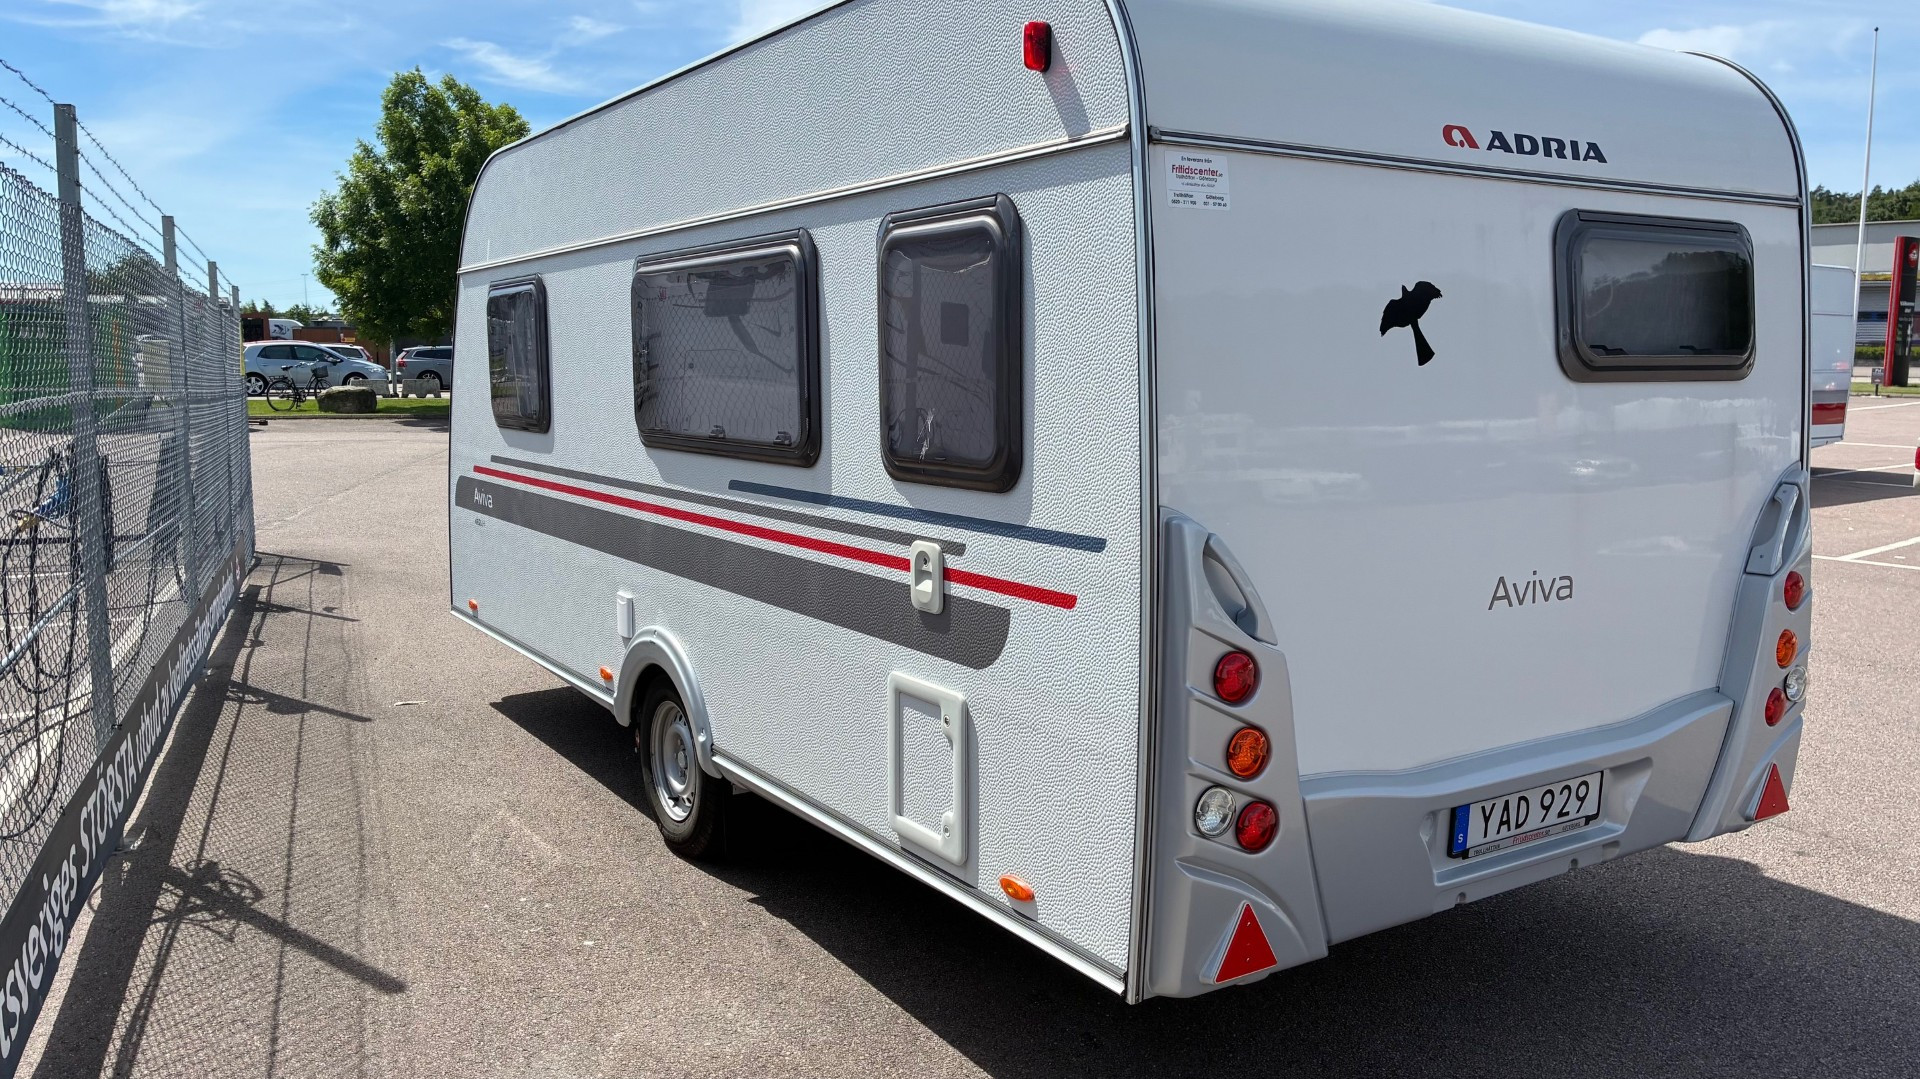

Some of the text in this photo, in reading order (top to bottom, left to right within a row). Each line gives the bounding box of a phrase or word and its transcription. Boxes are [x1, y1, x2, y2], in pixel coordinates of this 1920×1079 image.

[1486, 130, 1608, 163] ADRIA
[474, 487, 493, 508] Aviva
[1488, 570, 1574, 610] Aviva
[79, 740, 136, 878] STÖRSTA
[136, 681, 162, 775] utbud
[161, 679, 169, 725] av
[1481, 780, 1590, 838] YAD 929
[1458, 833, 1464, 843] S
